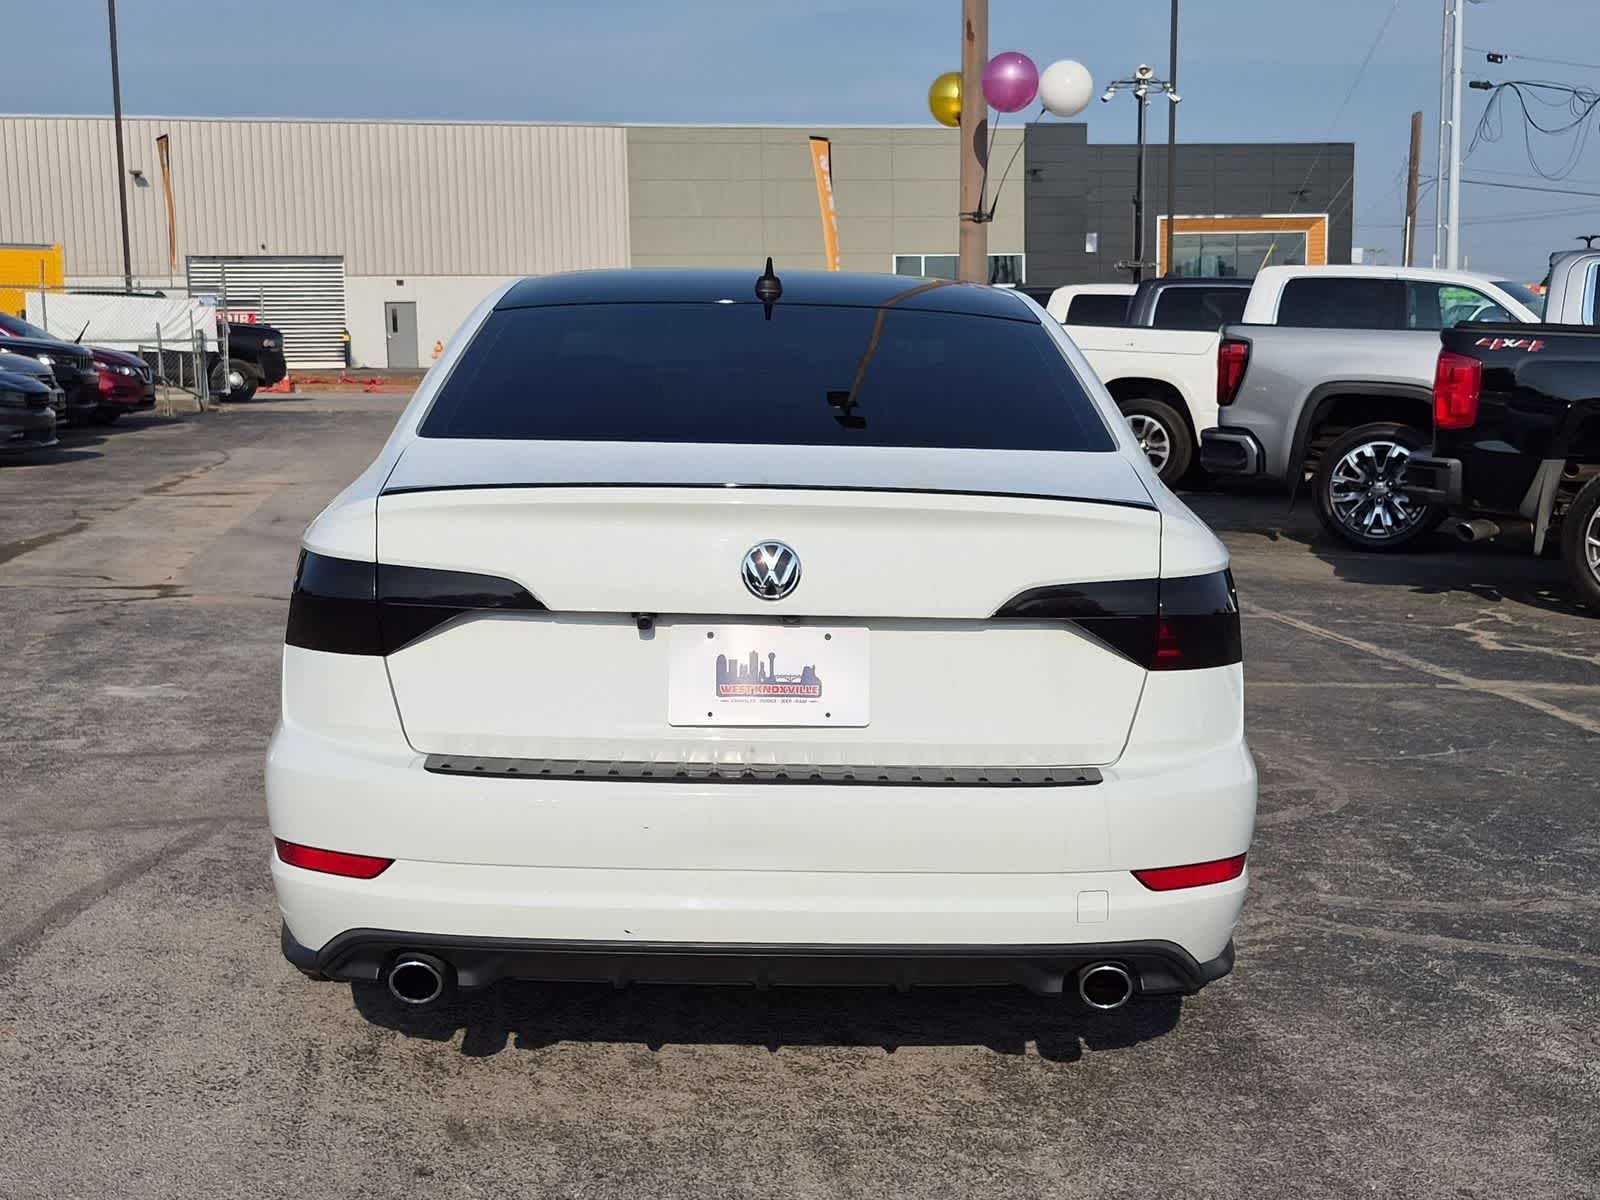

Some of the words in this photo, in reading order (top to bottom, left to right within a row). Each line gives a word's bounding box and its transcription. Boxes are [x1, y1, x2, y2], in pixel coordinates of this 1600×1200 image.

[742, 541, 801, 600] VW
[720, 684, 754, 694] WEST
[756, 685, 818, 694] KNOXVILLE
